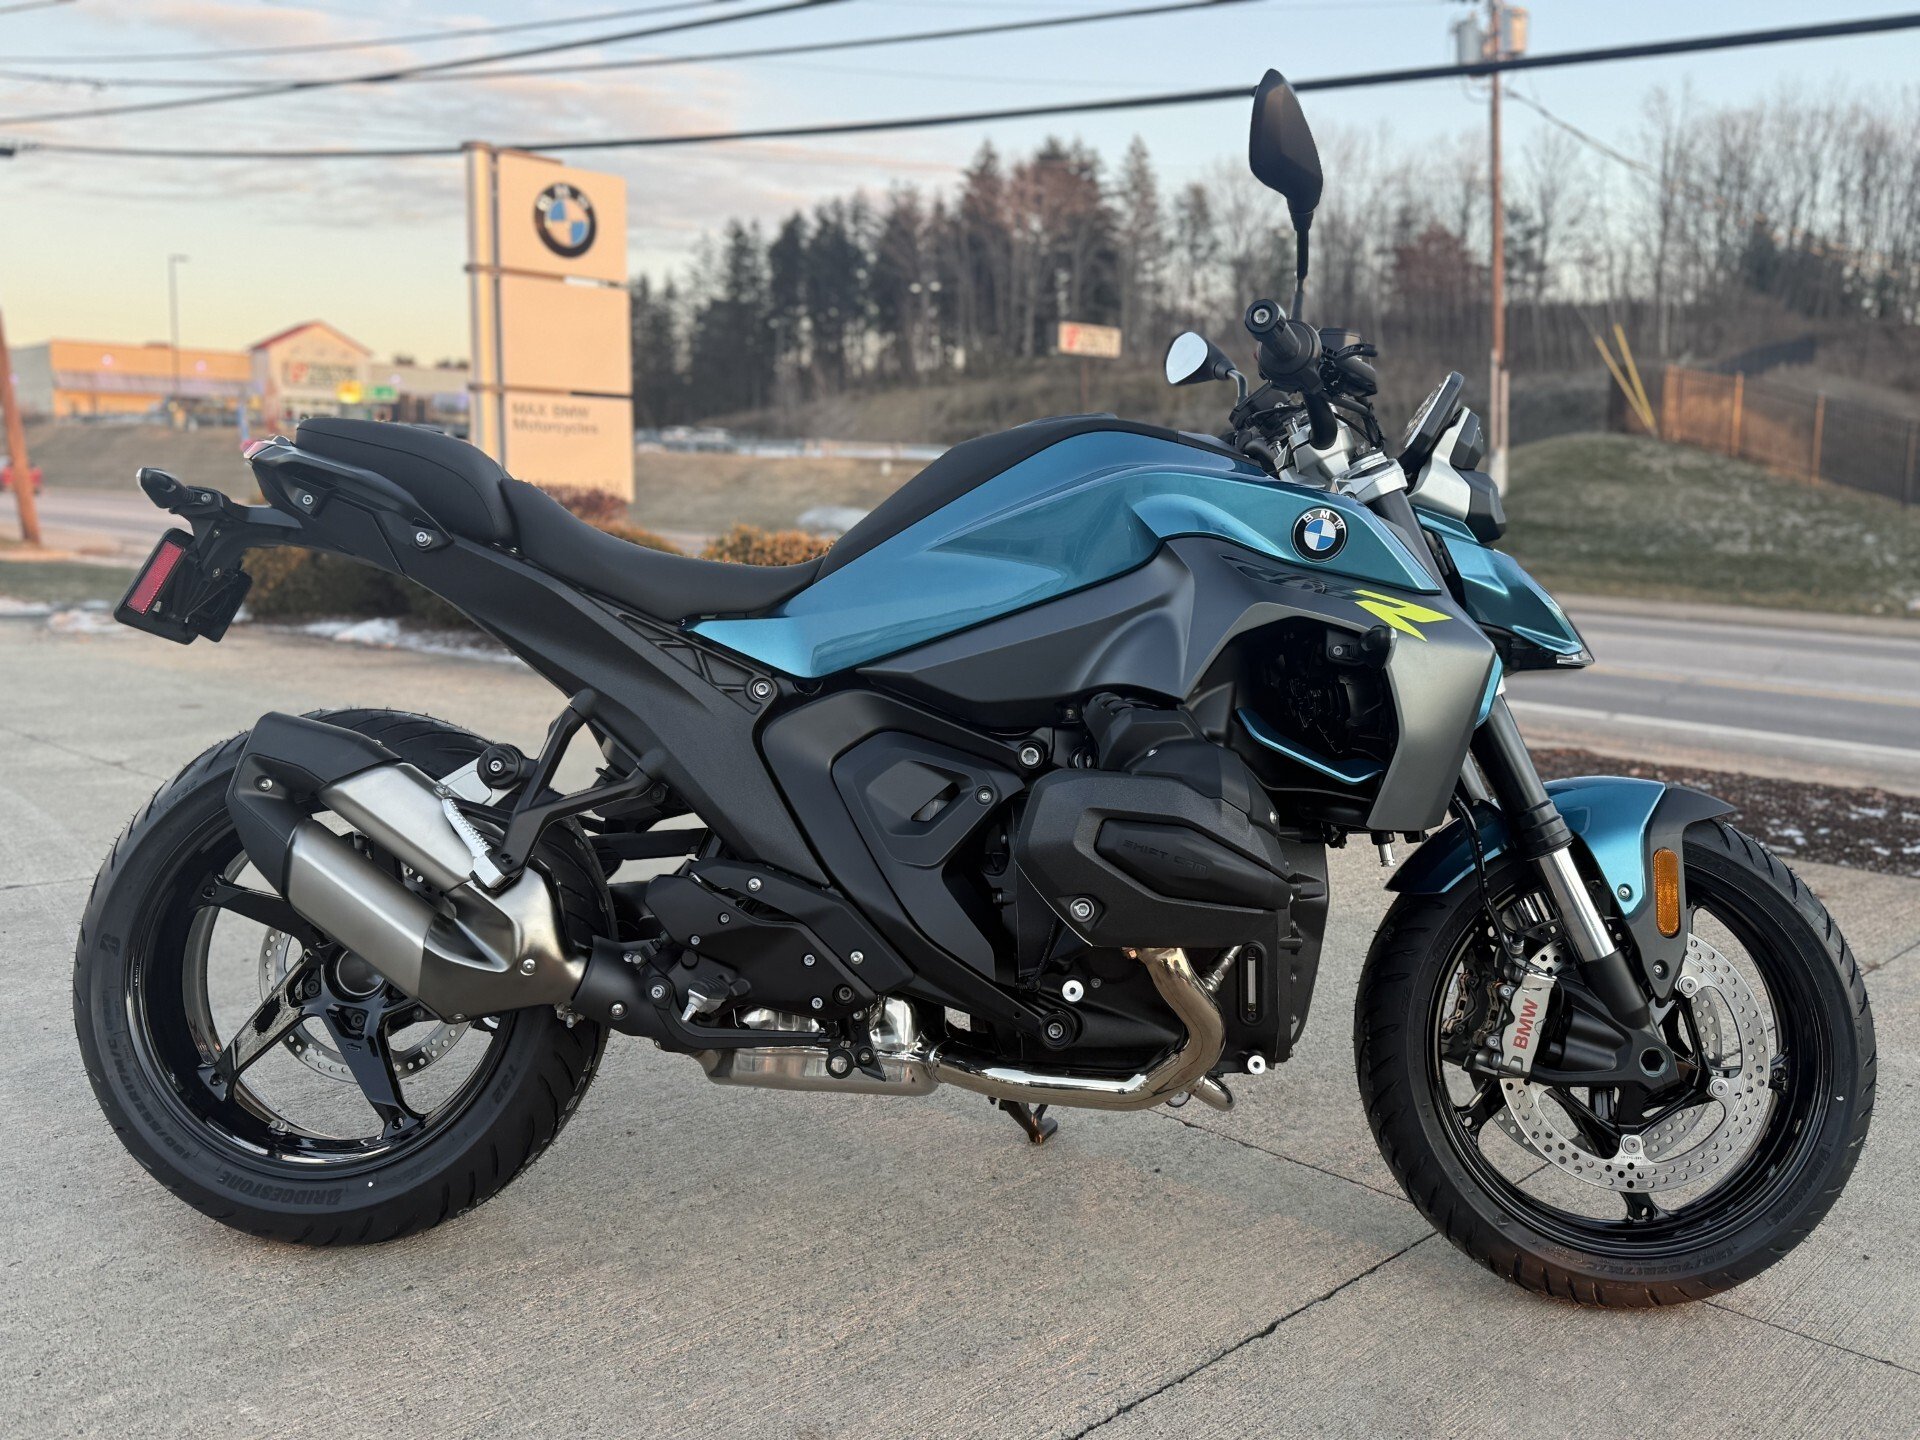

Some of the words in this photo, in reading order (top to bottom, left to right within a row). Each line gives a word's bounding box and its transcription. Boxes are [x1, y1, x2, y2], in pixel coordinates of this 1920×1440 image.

[512, 402, 547, 416] MAX
[552, 404, 590, 419] BMW
[511, 418, 600, 437] Motorcycles
[1513, 997, 1539, 1050] BMW
[218, 1170, 343, 1206] BRIDGESTONE
